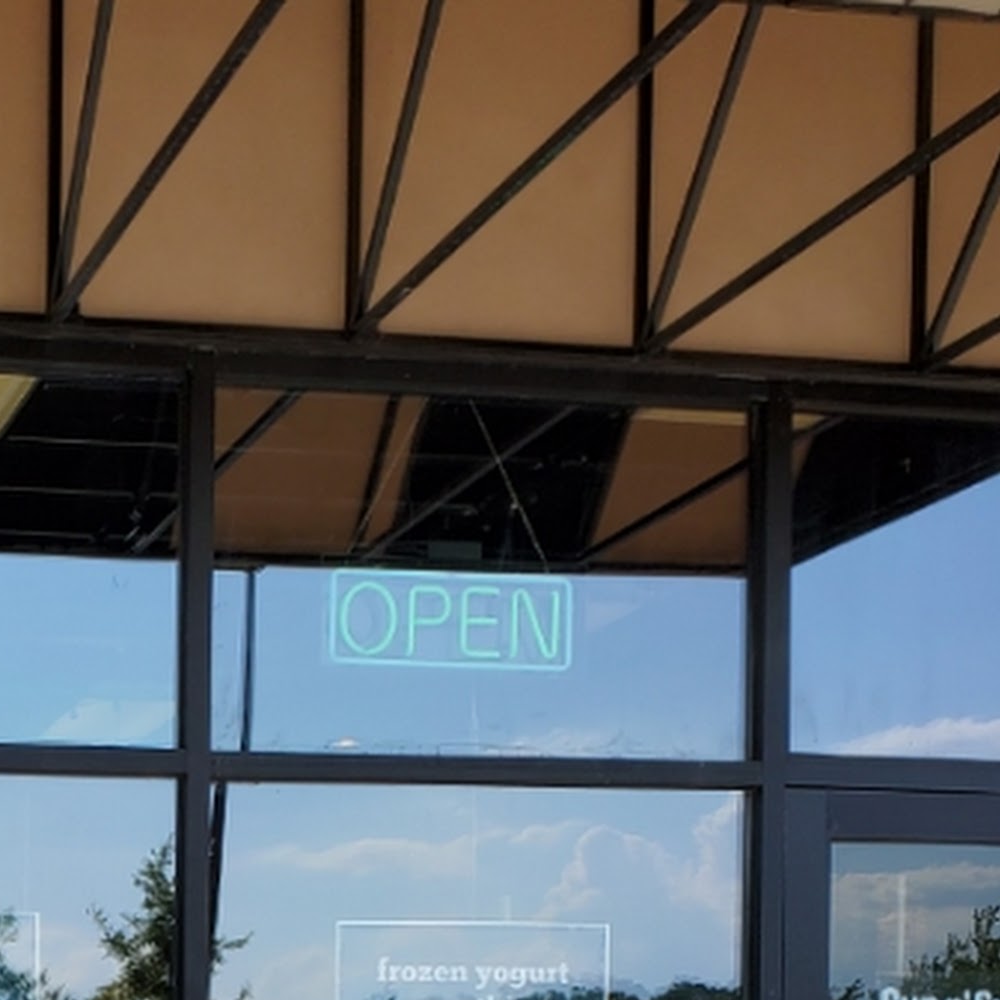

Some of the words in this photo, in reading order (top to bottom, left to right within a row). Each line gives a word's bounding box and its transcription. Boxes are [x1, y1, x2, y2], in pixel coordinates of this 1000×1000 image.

[339, 580, 561, 660] OPEN
[376, 957, 469, 984] frozen
[475, 962, 570, 989] yogurt
